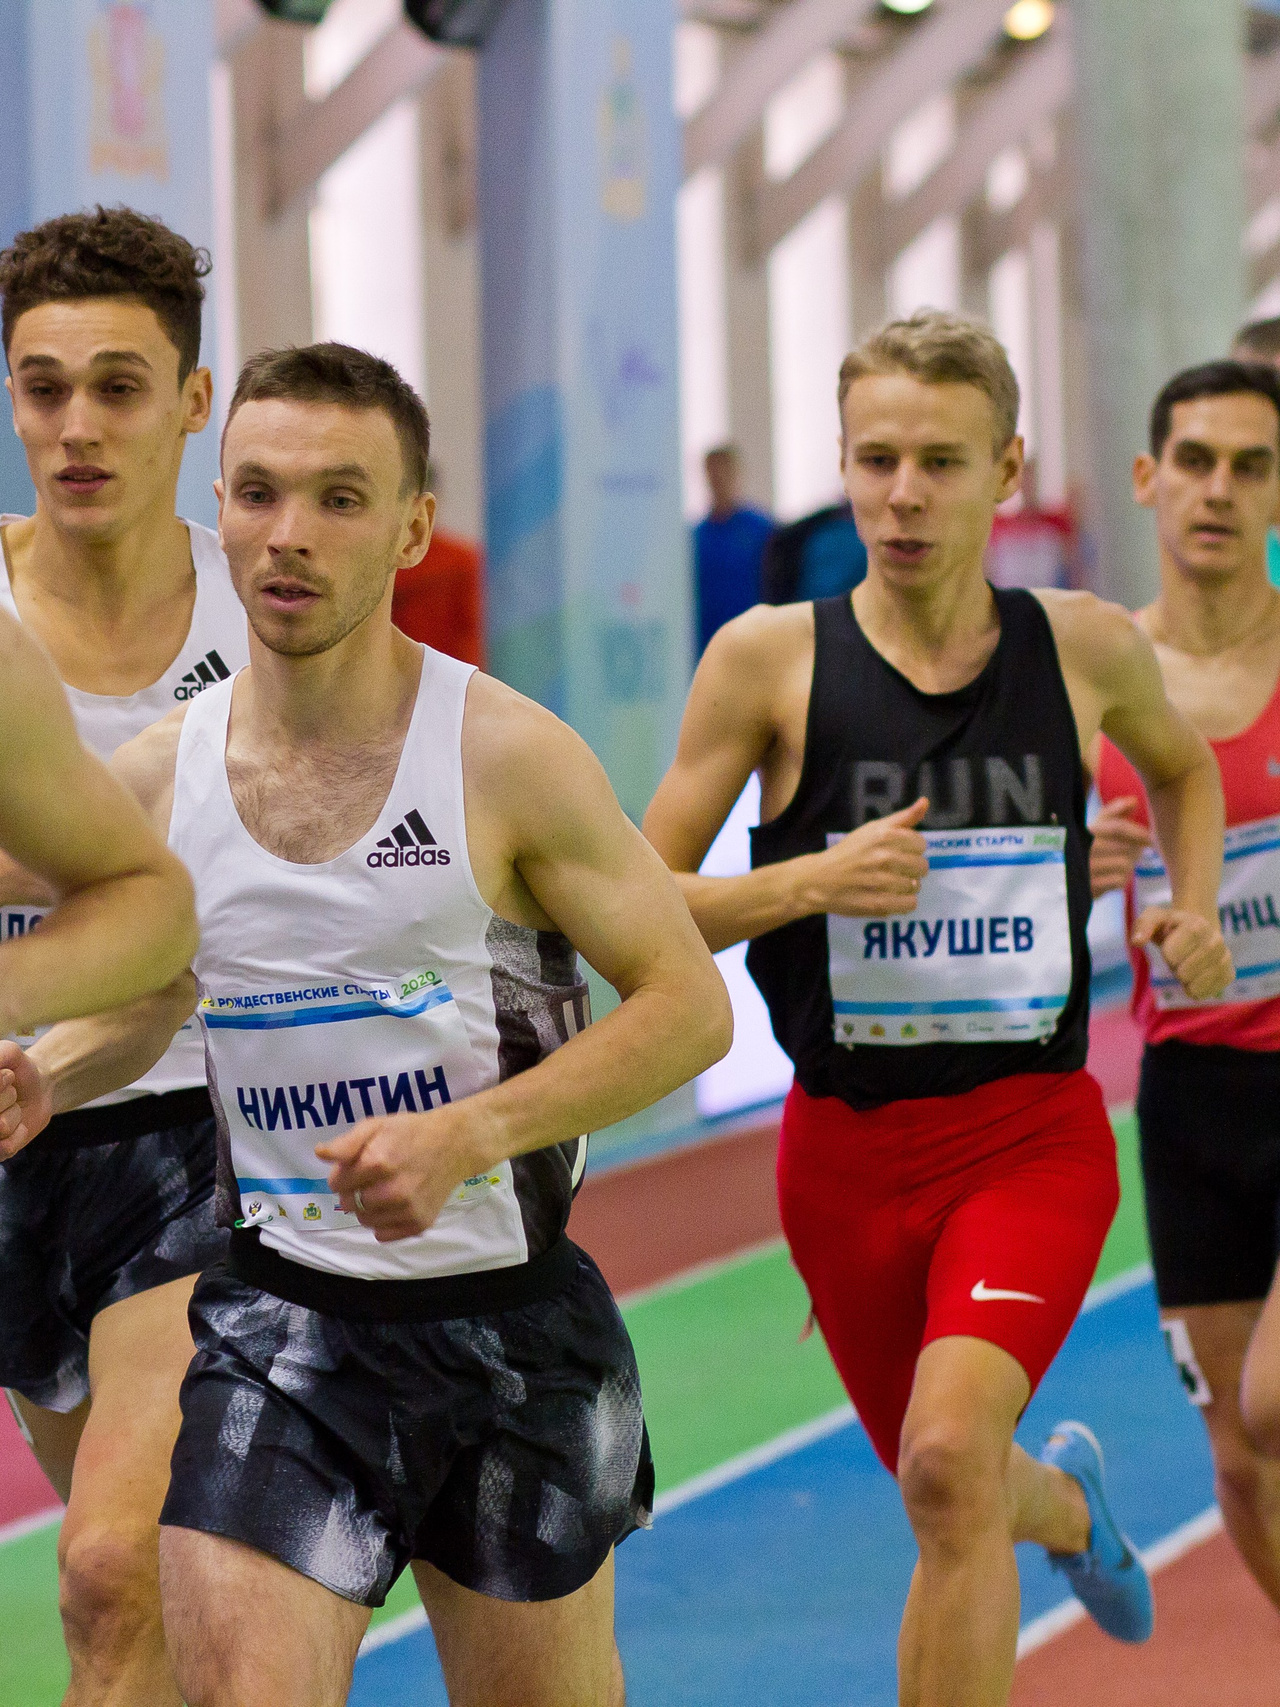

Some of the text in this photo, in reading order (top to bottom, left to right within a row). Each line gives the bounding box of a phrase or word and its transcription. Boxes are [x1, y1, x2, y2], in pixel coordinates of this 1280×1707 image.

[854, 753, 1042, 829] RUN
[366, 845, 451, 869] adidas
[863, 916, 1034, 960] ЯКУШЕВ
[218, 986, 340, 1009] РОЖДЕСТВЕНСКИЕ
[400, 970, 437, 997] 2020
[236, 1065, 452, 1132] НИКИТИН
